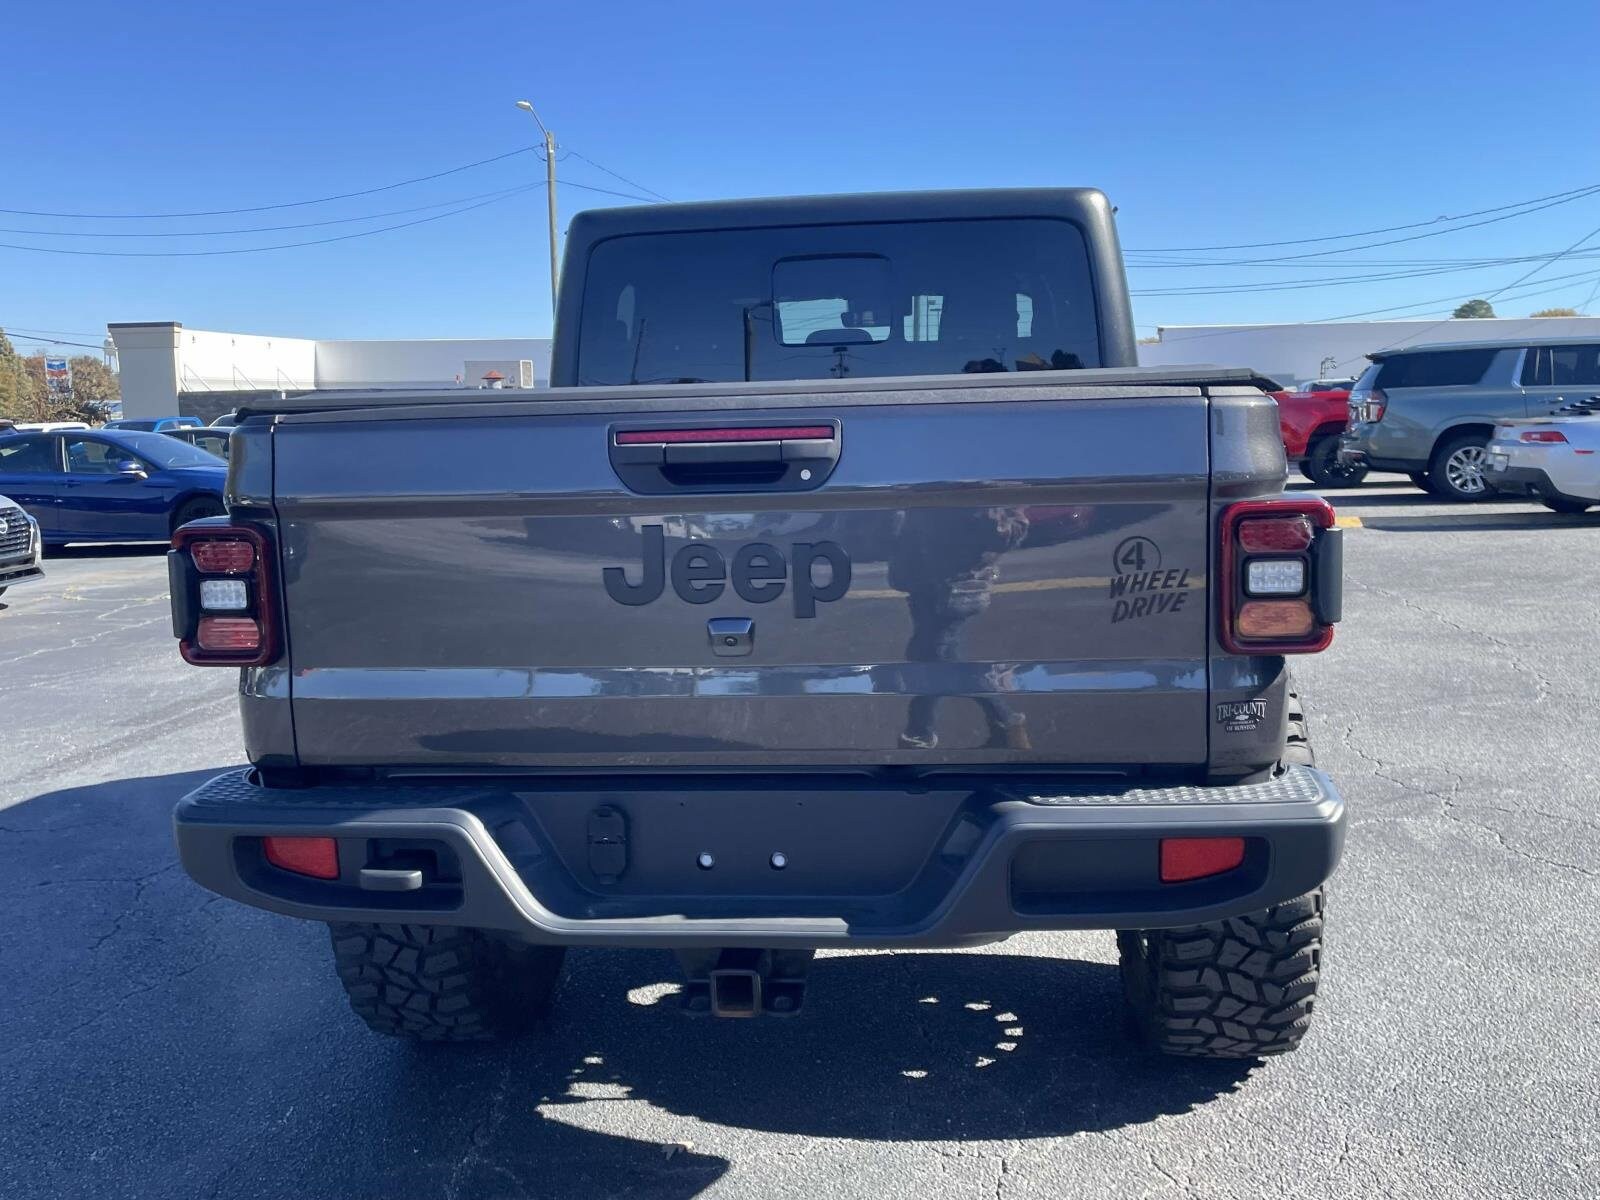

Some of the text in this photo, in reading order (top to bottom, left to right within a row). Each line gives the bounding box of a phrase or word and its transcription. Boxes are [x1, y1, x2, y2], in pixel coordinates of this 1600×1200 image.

[602, 524, 851, 618] Jeep
[1121, 541, 1146, 571] 4
[1110, 568, 1190, 599] WHEEL
[1111, 591, 1188, 624] DRIVE
[1216, 700, 1267, 721] TRI-COUNTY
